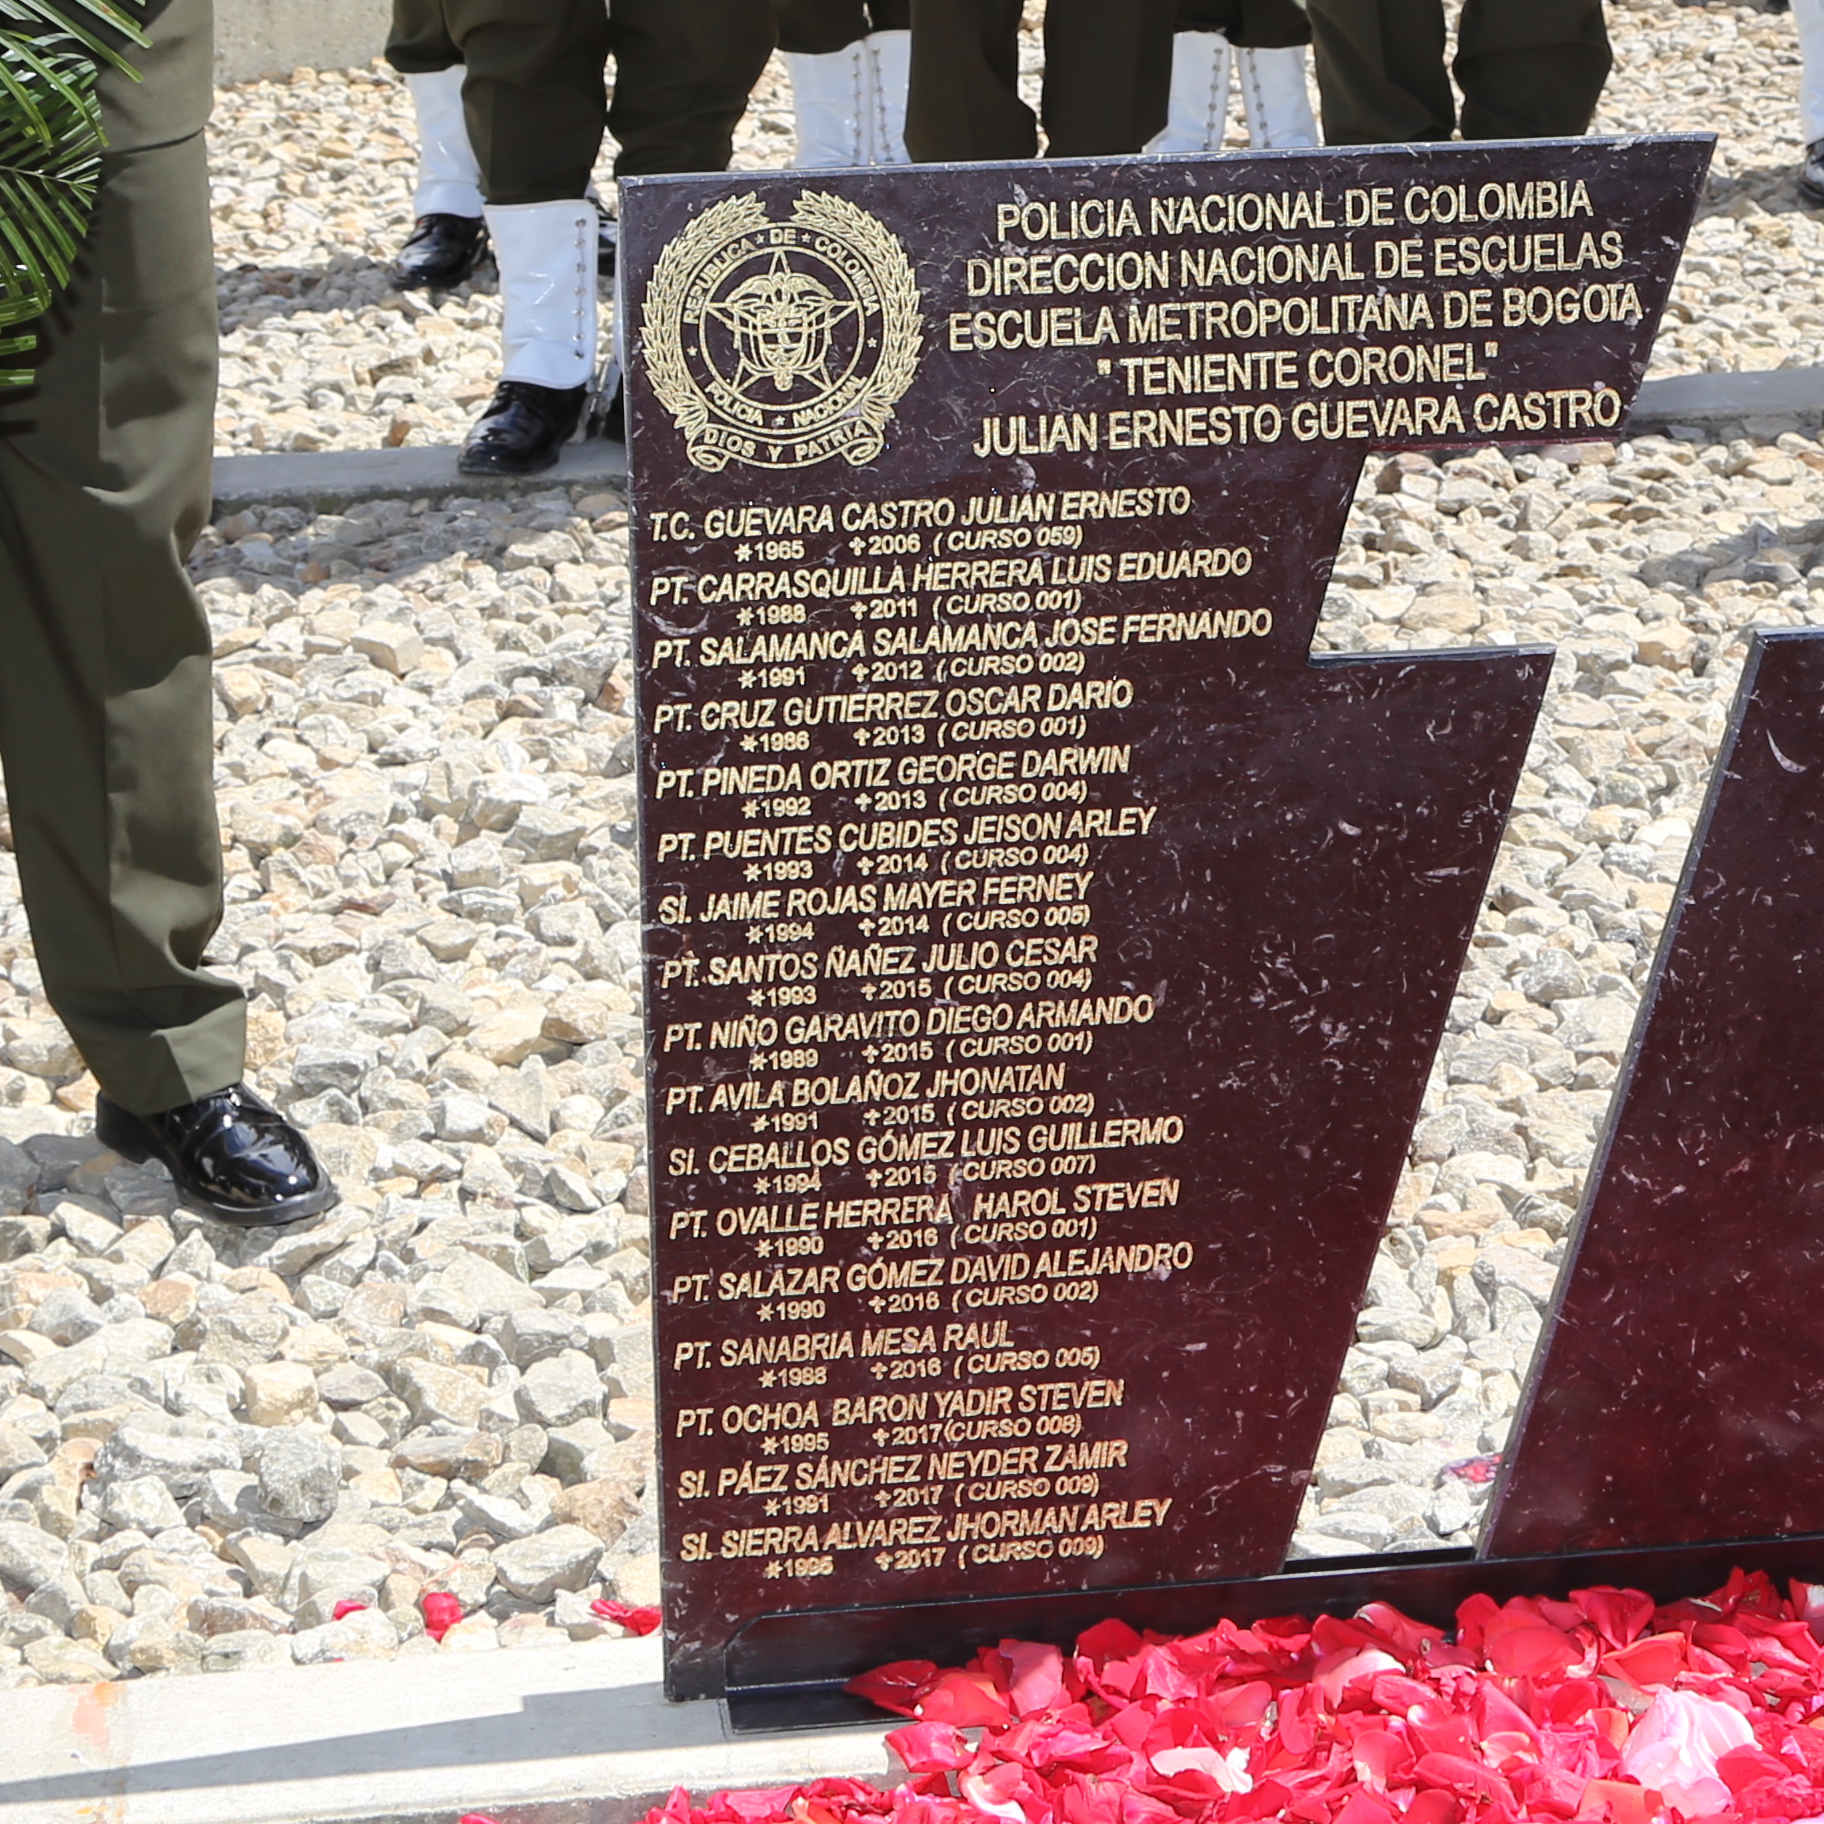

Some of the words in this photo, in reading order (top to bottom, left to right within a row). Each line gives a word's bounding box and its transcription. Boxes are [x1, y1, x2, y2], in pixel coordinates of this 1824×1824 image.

[996, 198, 1141, 243] POLICIA
[1150, 189, 1336, 236] NACIONAL
[1345, 187, 1394, 228] DE
[1403, 178, 1593, 225] COLOMBIA
[683, 238, 755, 324] REPUBLICA
[769, 228, 796, 245] DE
[814, 236, 880, 317] COLOMBIA
[966, 250, 1170, 298] DIRECCION
[1179, 241, 1364, 288] NACIONAL
[1373, 238, 1423, 279] DE
[1434, 230, 1623, 277] ESCUELAS
[947, 304, 1118, 352] ESCUELA
[1128, 290, 1434, 344] METROPOLITANA
[1444, 287, 1492, 330] DE
[1502, 281, 1643, 327] BOGOTA
[1306, 340, 1498, 389] CORONEL"
[704, 380, 764, 426] POLICIA
[792, 375, 868, 427] NACIONAL
[972, 411, 1097, 457] JULIAN
[1108, 402, 1281, 451] ERNESTO
[1290, 394, 1465, 442] GUEVARA
[1472, 386, 1621, 434] CASTRO
[704, 428, 756, 457] DIOS
[768, 444, 782, 462] Y
[795, 420, 870, 461] PATRIA
[649, 509, 695, 542] T.C.
[702, 502, 835, 539] GUEVARA
[841, 497, 955, 532] CASTRO
[959, 492, 1053, 526] JULIAN
[1059, 485, 1190, 522] ERNESTO
[649, 575, 689, 607] PT.
[696, 564, 905, 604] CARRASQUILLA
[911, 557, 1044, 594] HERRERA
[1049, 554, 1112, 587] LUIS
[1117, 547, 1252, 583] EDUARDO
[650, 637, 691, 669] PT.
[698, 628, 866, 667] SALAMANCA
[871, 619, 1038, 658] SALAMANCA
[1044, 615, 1115, 649] JOSE
[1120, 607, 1272, 645] FERNANDO
[652, 702, 693, 734] PT.
[699, 697, 776, 731] CRUZ
[782, 689, 940, 727] GUTIERREZ
[946, 683, 1041, 718] OSCAR
[655, 768, 695, 799] PT.
[701, 762, 803, 797] PINEDA
[809, 757, 891, 791] ORTIZ
[897, 751, 1014, 786] GEORGE
[1021, 745, 1131, 780] DARWIN
[657, 831, 697, 863] PT.
[702, 824, 832, 860] PUENTES
[837, 817, 957, 853] CUBIDES
[962, 811, 1065, 846] JEISON
[1063, 806, 1157, 840] ARLEY
[658, 894, 693, 926] SI.
[699, 890, 780, 924] JAIME
[785, 884, 876, 919] ROJAS
[883, 879, 976, 914] MAYER
[981, 872, 1093, 908] FERNEY
[660, 957, 700, 989] PT.
[707, 951, 818, 986] SANTOS
[921, 940, 999, 974] JULIO
[1004, 935, 1098, 969] CESAR
[662, 1020, 703, 1052] PT.
[709, 1012, 775, 1049] NIÑO
[785, 1007, 920, 1045] GARAVITO
[925, 1002, 1012, 1036] DIEGO
[1016, 994, 1153, 1031] ARMANDO
[665, 1083, 705, 1115] PT.
[709, 1078, 784, 1112] AVILA
[791, 1067, 921, 1107] BOLAÑOZ
[925, 1061, 1065, 1099] JHONATAN
[667, 1146, 700, 1176] SI.
[708, 1137, 850, 1174] CEBALLOS
[856, 1126, 954, 1165] GÓMEZ
[960, 1126, 1020, 1159] LUIS
[1027, 1116, 1183, 1155] GUILLERMO
[668, 1208, 709, 1240] PT.
[715, 1201, 819, 1237] OVALLE
[823, 1193, 952, 1231] HERRERA
[972, 1186, 1065, 1221] HAROL
[1072, 1179, 1179, 1215] STEVEN
[671, 1271, 711, 1303] PT.
[718, 1263, 839, 1300] SALAZAR
[845, 1253, 945, 1292] GÓMEZ
[950, 1251, 1030, 1286] DAVID
[1033, 1241, 1193, 1280] ALEJANDRO
[673, 1339, 713, 1371] PT.
[720, 1330, 854, 1368] SANABRIA
[860, 1325, 936, 1359] MESA
[942, 1320, 1014, 1353] RAUL
[675, 1405, 715, 1437] PT.
[721, 1398, 819, 1434] OCHOA
[831, 1391, 928, 1427] BARON
[933, 1386, 1011, 1420] YADIR
[1018, 1378, 1124, 1415] STEVEN
[677, 1467, 711, 1499] SI.
[717, 1458, 788, 1497] PÁEZ
[794, 1449, 922, 1492] SÁNCHEZ
[927, 1445, 1037, 1483] NEYDER
[1044, 1439, 1128, 1475] ZAMIR
[679, 1528, 713, 1562] SI.
[720, 1521, 818, 1559] SIERRA
[821, 1513, 941, 1552] ALVAREZ
[946, 1504, 1077, 1544] JHORMAN
[1080, 1497, 1172, 1535] ARLEY
